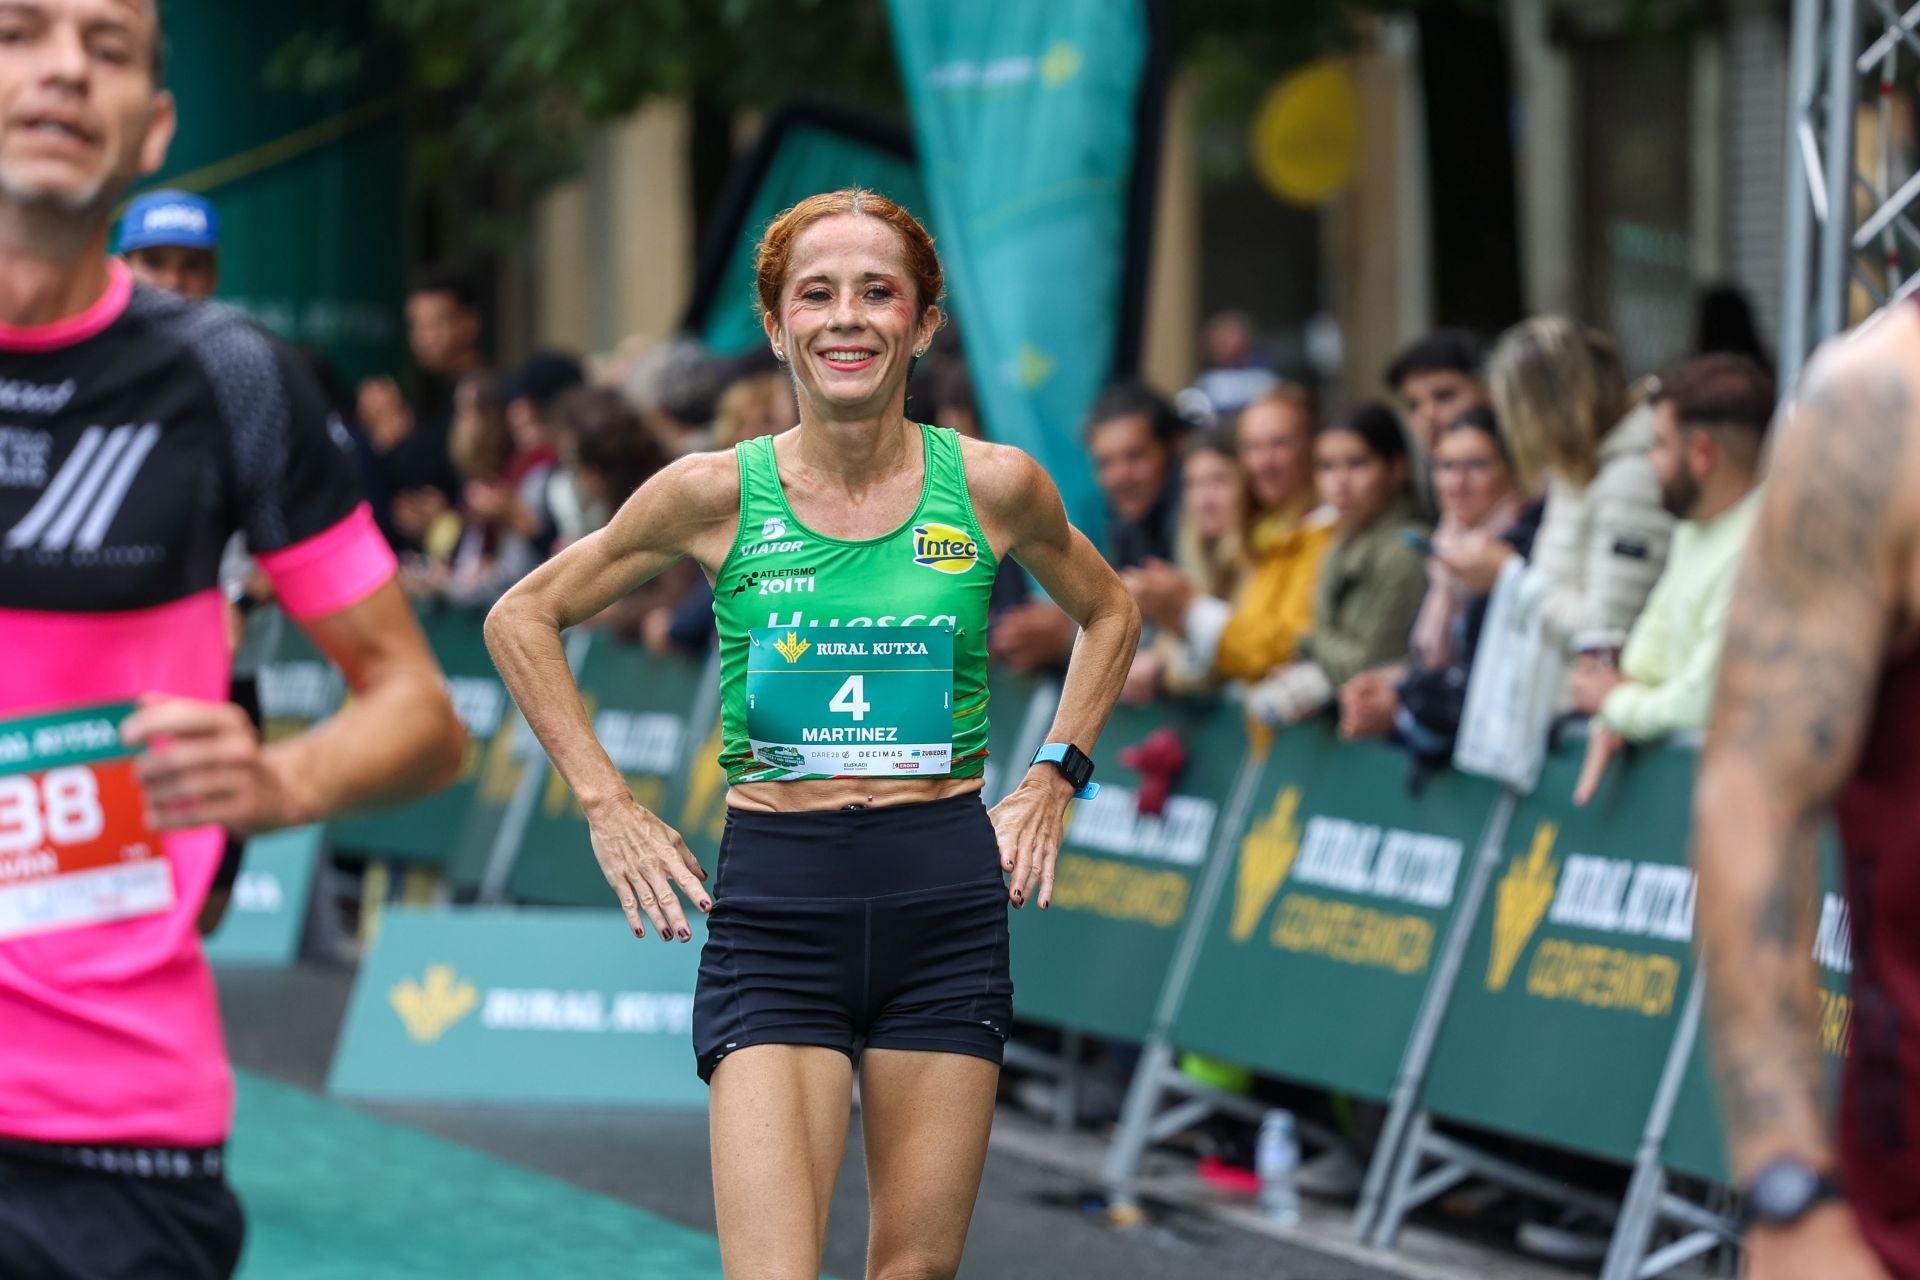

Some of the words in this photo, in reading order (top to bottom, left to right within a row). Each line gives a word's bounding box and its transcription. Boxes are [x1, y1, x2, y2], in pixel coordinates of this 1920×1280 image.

[741, 541, 803, 556] VIATOR
[760, 568, 816, 579] ATLETISMO
[758, 577, 815, 595] ZOITI
[817, 643, 868, 655] RURAL
[873, 643, 928, 655] KUTXA
[829, 675, 870, 721] 4
[802, 727, 897, 741] MARTINEZ
